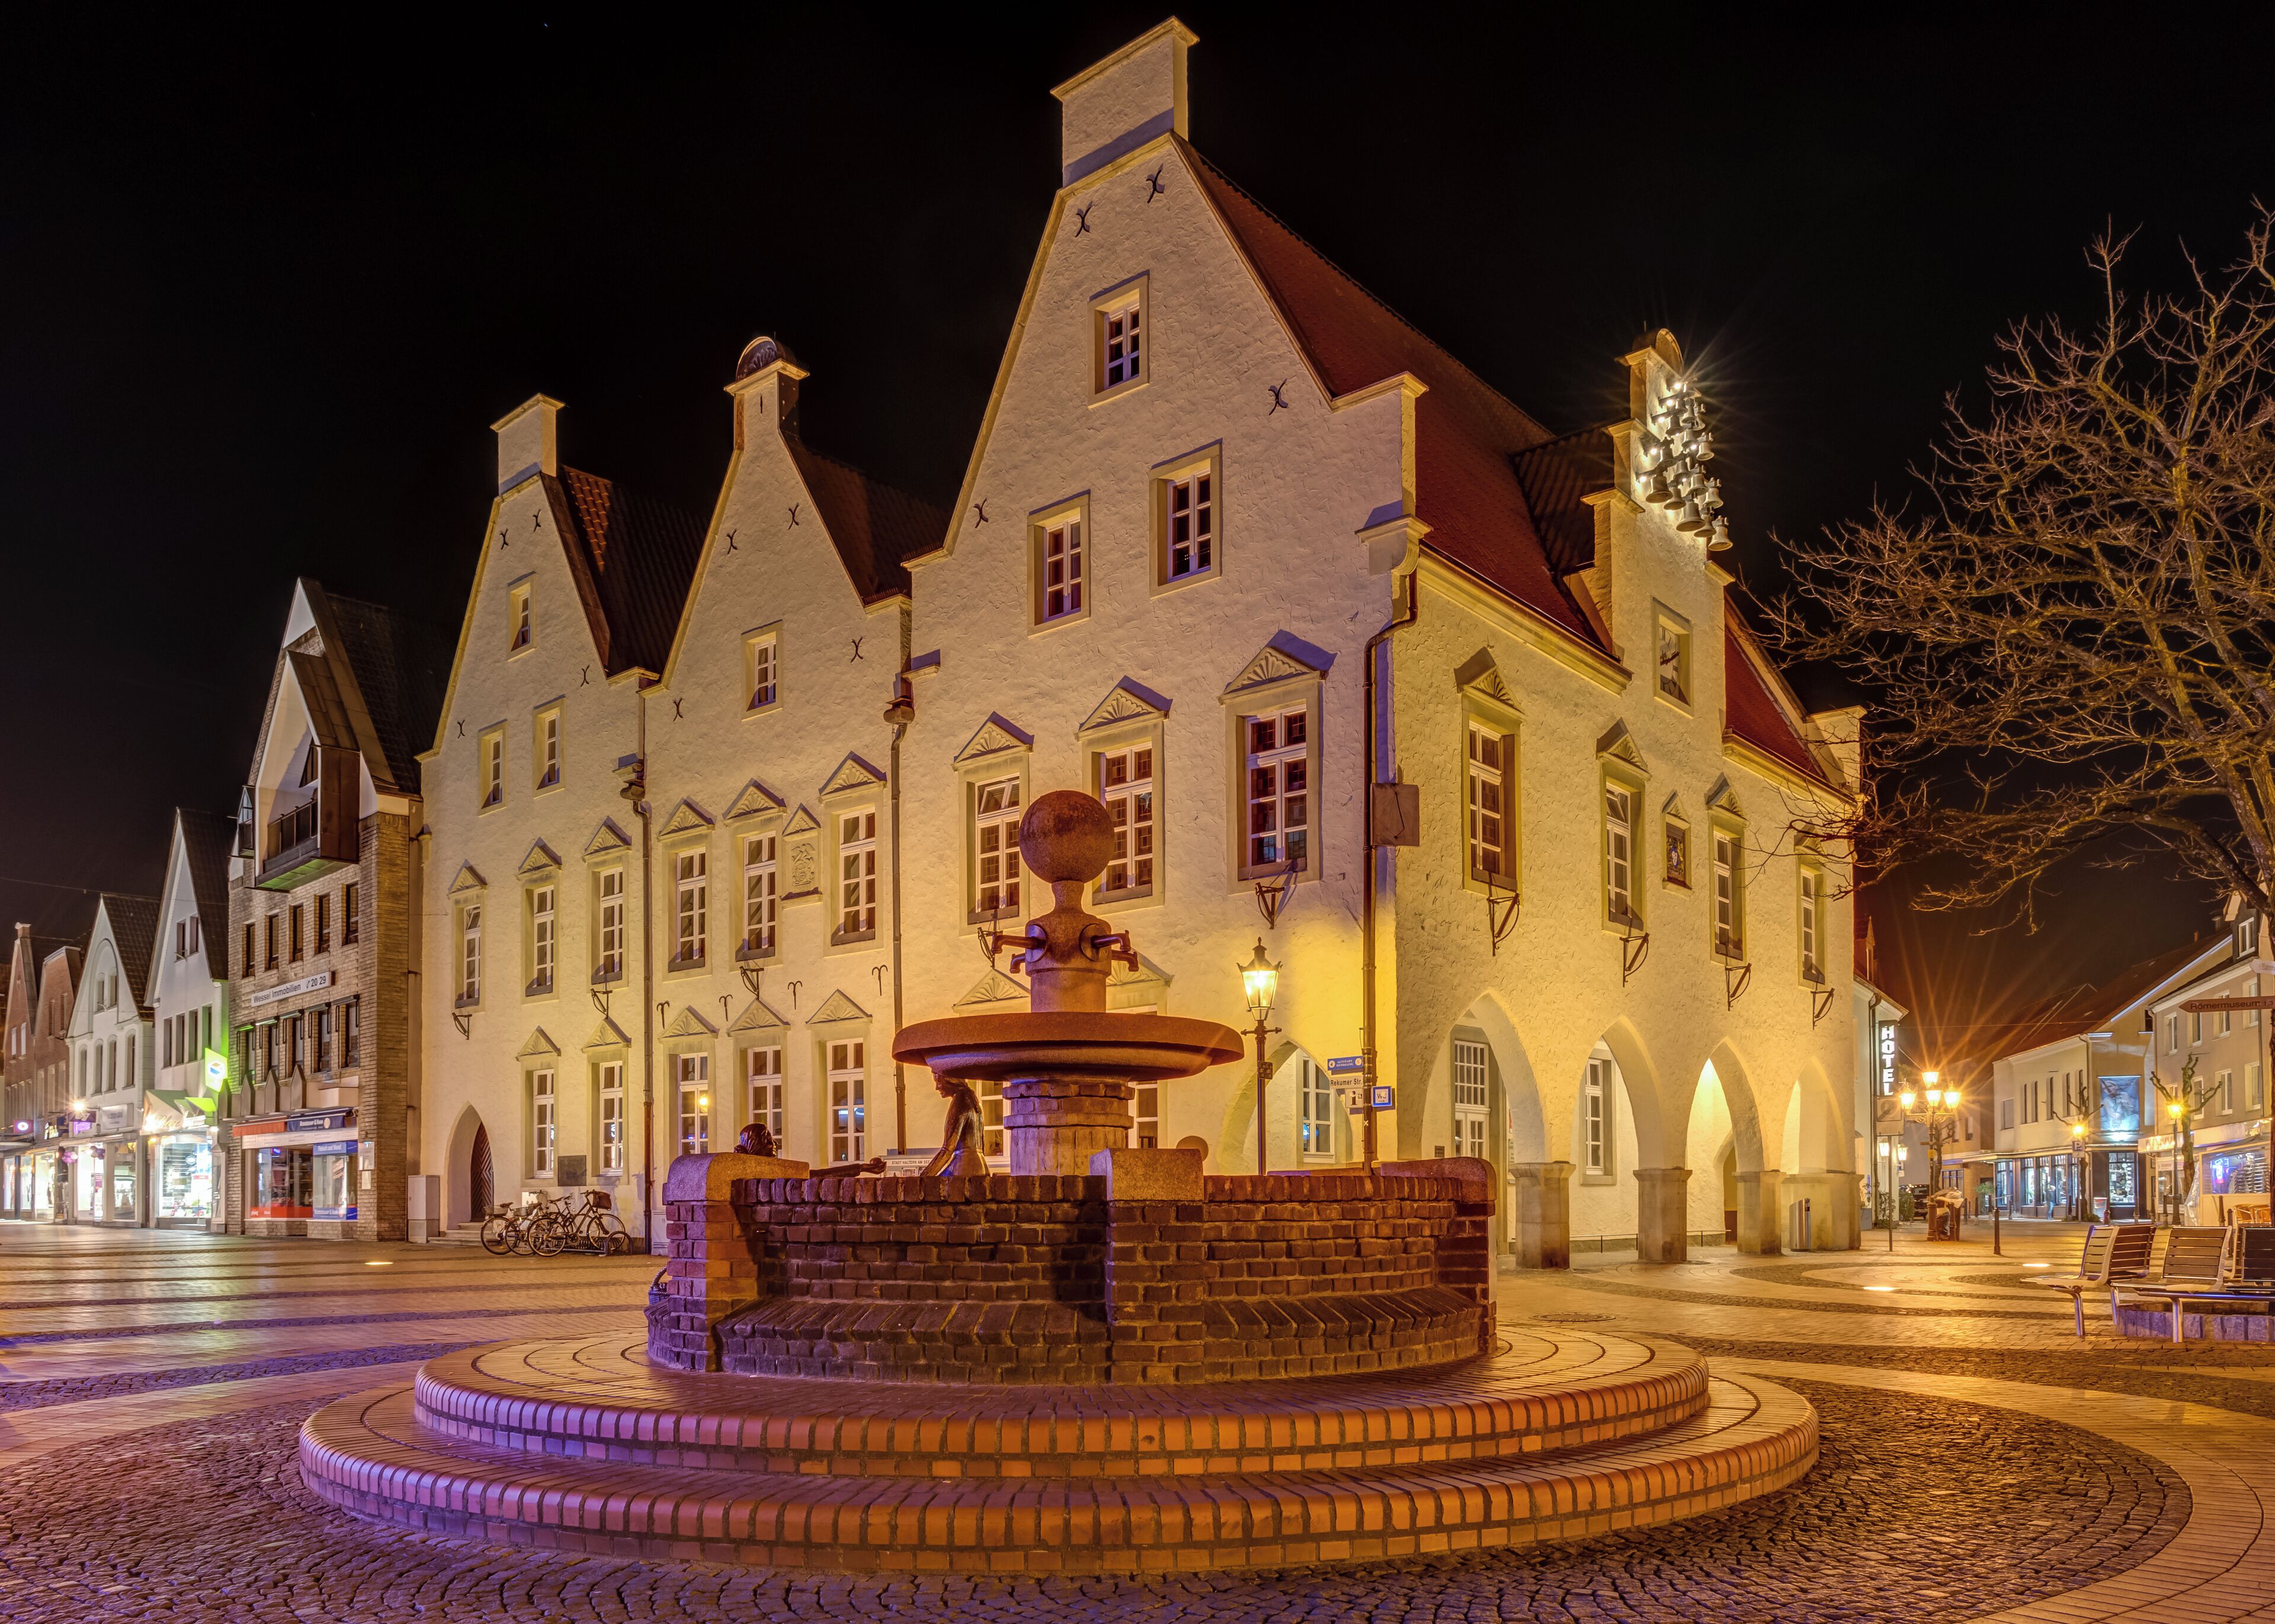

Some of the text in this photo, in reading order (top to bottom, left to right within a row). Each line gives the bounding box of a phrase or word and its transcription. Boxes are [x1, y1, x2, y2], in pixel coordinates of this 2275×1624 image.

[253, 975, 326, 1003] Wessel Immobilien 20 29
[2190, 1000, 2260, 1010] Römermuseum
[1882, 1025, 1895, 1096] HOTEL
